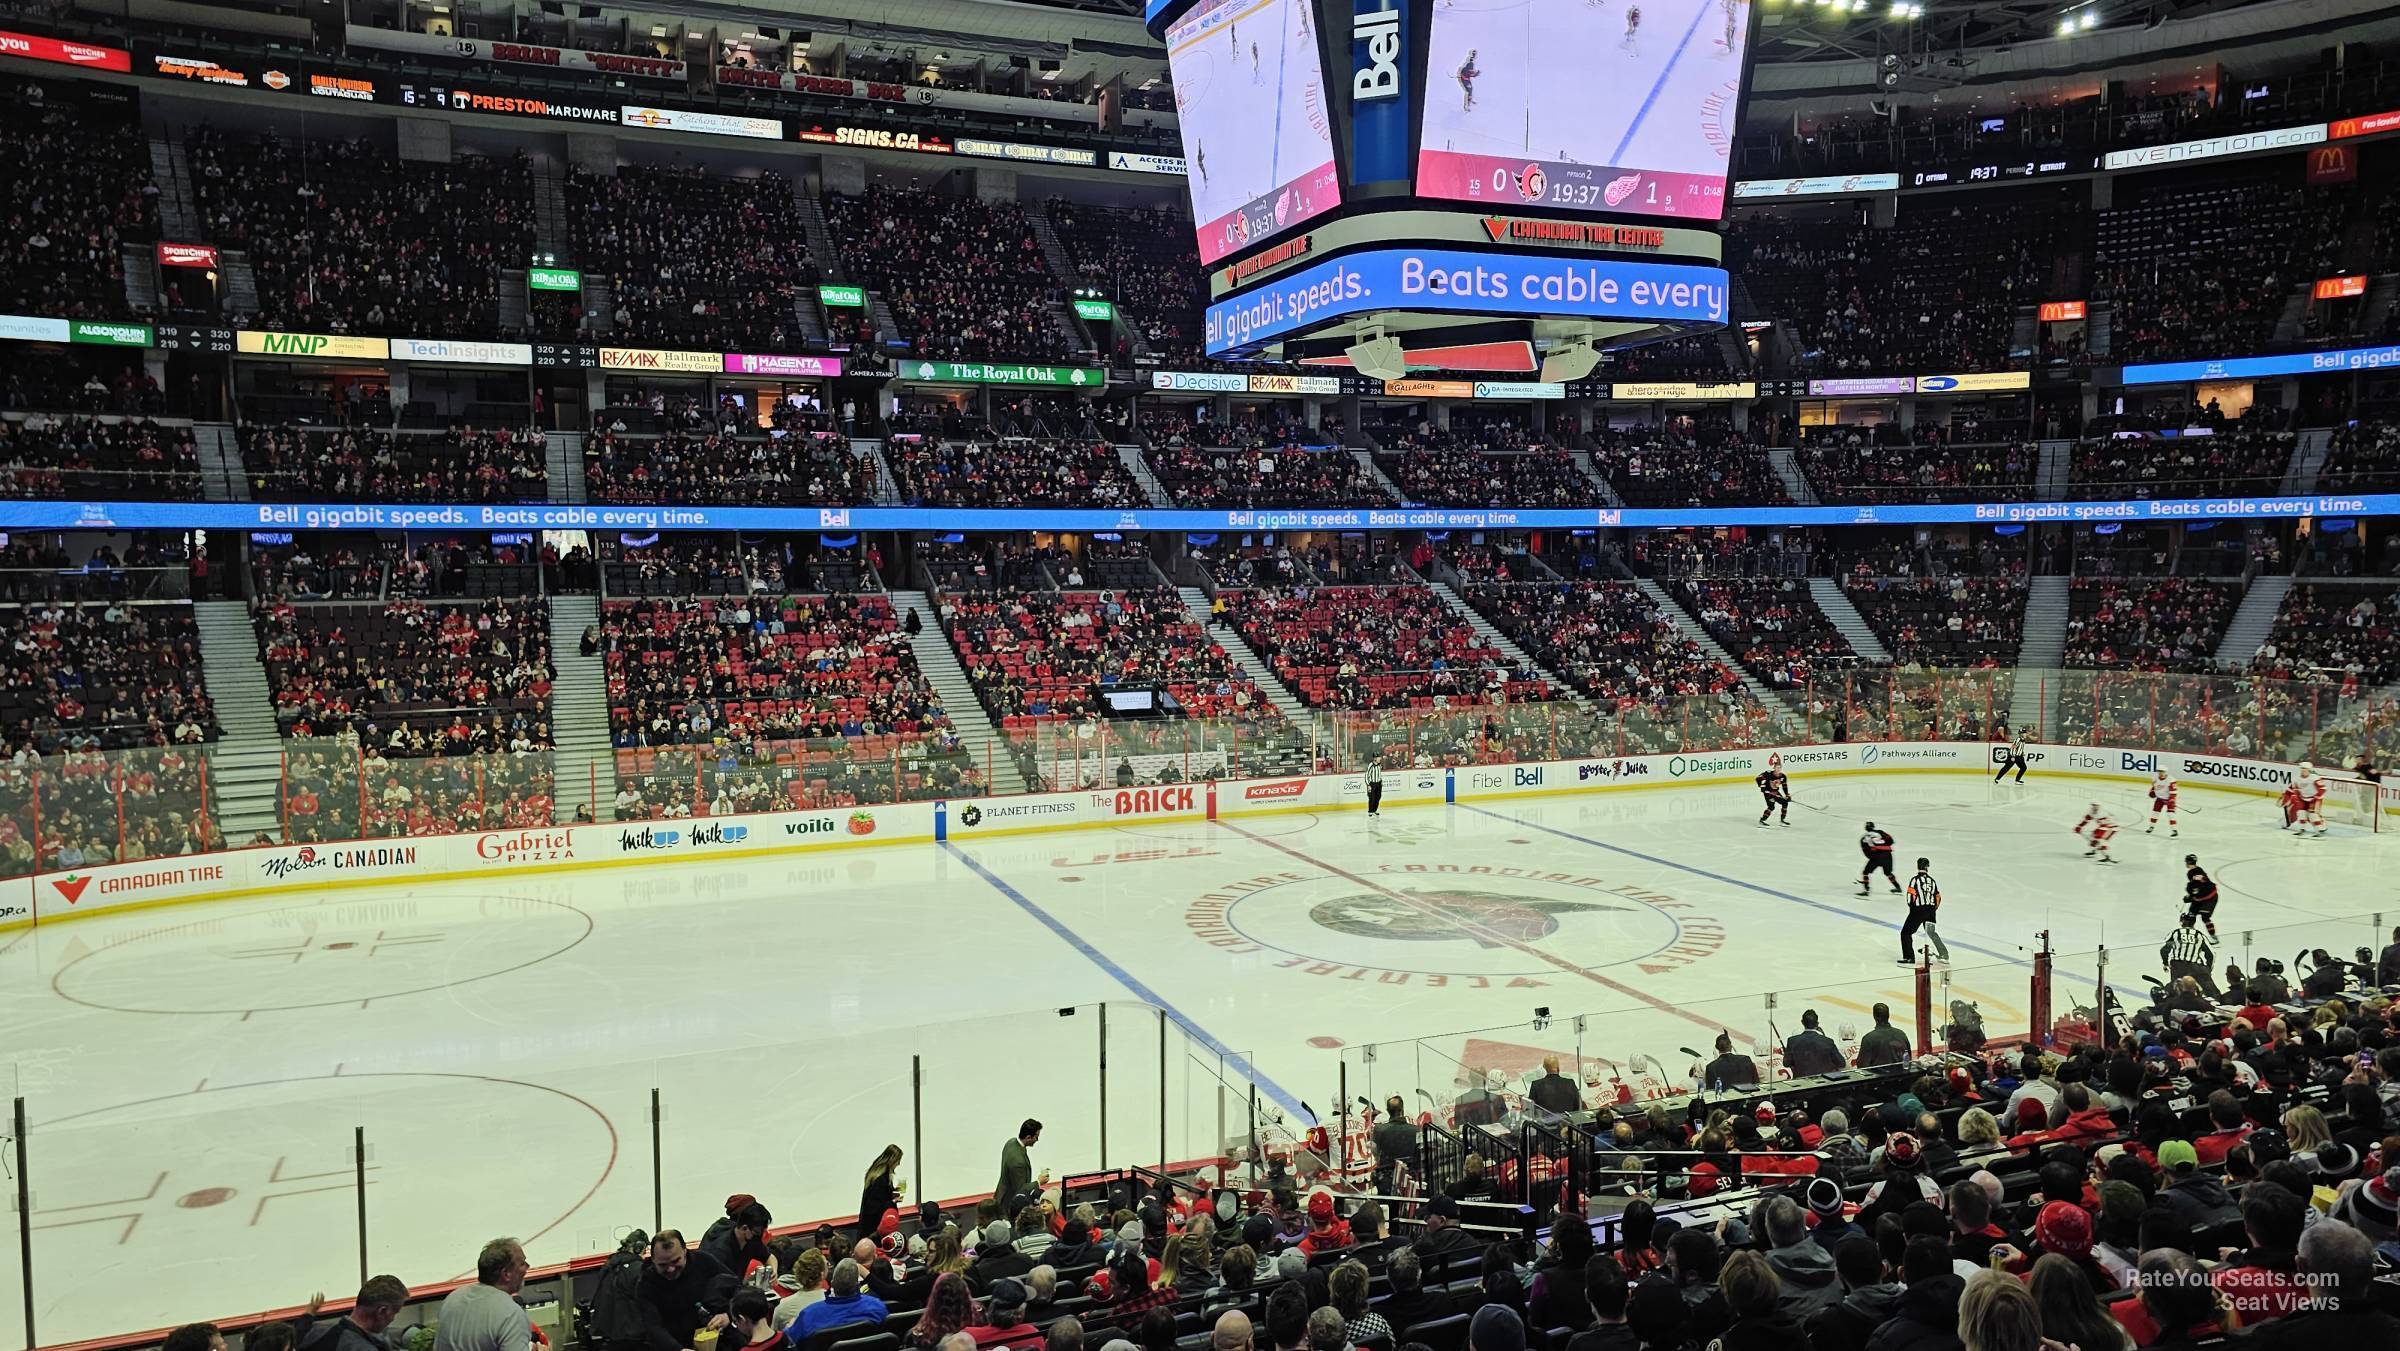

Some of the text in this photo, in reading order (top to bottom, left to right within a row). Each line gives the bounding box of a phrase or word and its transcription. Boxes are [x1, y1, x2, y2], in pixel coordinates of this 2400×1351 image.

[0, 37, 30, 51] you
[458, 41, 474, 54] 18
[1354, 10, 1400, 100] Bell
[492, 43, 560, 65] BRIAN
[719, 67, 781, 88] SMITH
[795, 76, 853, 96] PRESS
[867, 83, 906, 102] BOX
[919, 91, 932, 102] 18
[835, 127, 919, 150] SIGNS.CA
[1139, 157, 1174, 165] ACCESS
[1493, 168, 1507, 192] 0
[1586, 169, 1592, 180] 2
[1915, 173, 1924, 185] 0
[1970, 166, 1998, 180] 19:37
[2025, 163, 2034, 176] 2
[1469, 179, 1481, 189] 15
[1689, 184, 1722, 196] 71 0:48
[1552, 183, 1600, 204] 19:37
[1646, 182, 1656, 204] 1
[1665, 195, 1672, 205] 9
[1226, 224, 1233, 243] 0
[1252, 213, 1273, 238] 19:37
[1511, 219, 1665, 246] CANADIAN TIRE CENTRE
[1226, 291, 1285, 345] gigabit
[1289, 264, 1371, 319] speeds.
[1402, 258, 1509, 299] Beats
[1522, 264, 1619, 304] cable
[1632, 277, 1723, 319] every
[159, 327, 178, 336] 319
[210, 329, 231, 339] 320
[161, 340, 179, 349] 219
[211, 342, 231, 352] 220
[263, 334, 328, 354] MNP
[409, 341, 516, 360] TechInsights
[537, 345, 554, 354] 320
[579, 347, 595, 356] 321
[538, 357, 555, 366] 220
[580, 358, 595, 367] 221
[602, 350, 720, 368] RE/MAX Hallmark
[664, 361, 721, 373] Realty Group
[758, 357, 821, 369] MAGENTA
[2313, 353, 2345, 368] Bell
[950, 364, 1056, 383] The Royal Oak
[1175, 374, 1241, 390] Decisive
[1251, 376, 1337, 390] RE/MAX Hallmark
[259, 506, 850, 528] Bell gigabit speeds. Beats cable every time. Bell
[1976, 498, 2367, 521] Bell gigabit speeds. Beats cable every time.
[1228, 509, 1621, 529] Bell gigabit speeds. Beats cable every time. Bell
[1129, 540, 1141, 548] 116
[1783, 751, 1848, 763] POKERSTARS
[1881, 749, 1956, 760] Pathways Alliance
[2069, 753, 2105, 769] Fibe
[2122, 753, 2159, 772] Bell
[1579, 761, 1648, 780] Booster Juice
[1691, 757, 1752, 773] Desjardins
[1473, 773, 1502, 788] Fibe
[1515, 767, 1542, 786] Bell
[1250, 784, 1298, 796] kinaxis
[1091, 787, 1194, 815] The BRICK
[987, 801, 1076, 818] PLANET FITNESS
[785, 818, 834, 835] voilà
[477, 828, 573, 860] Gabriel
[261, 847, 417, 878] Molson CANADIAN
[508, 850, 574, 862] PIZZA
[100, 866, 223, 895] CANADIAN TIRE
[1222, 872, 1305, 892] TIRE
[1379, 864, 1603, 886] CANADIAN
[1610, 885, 1695, 909] TIRE
